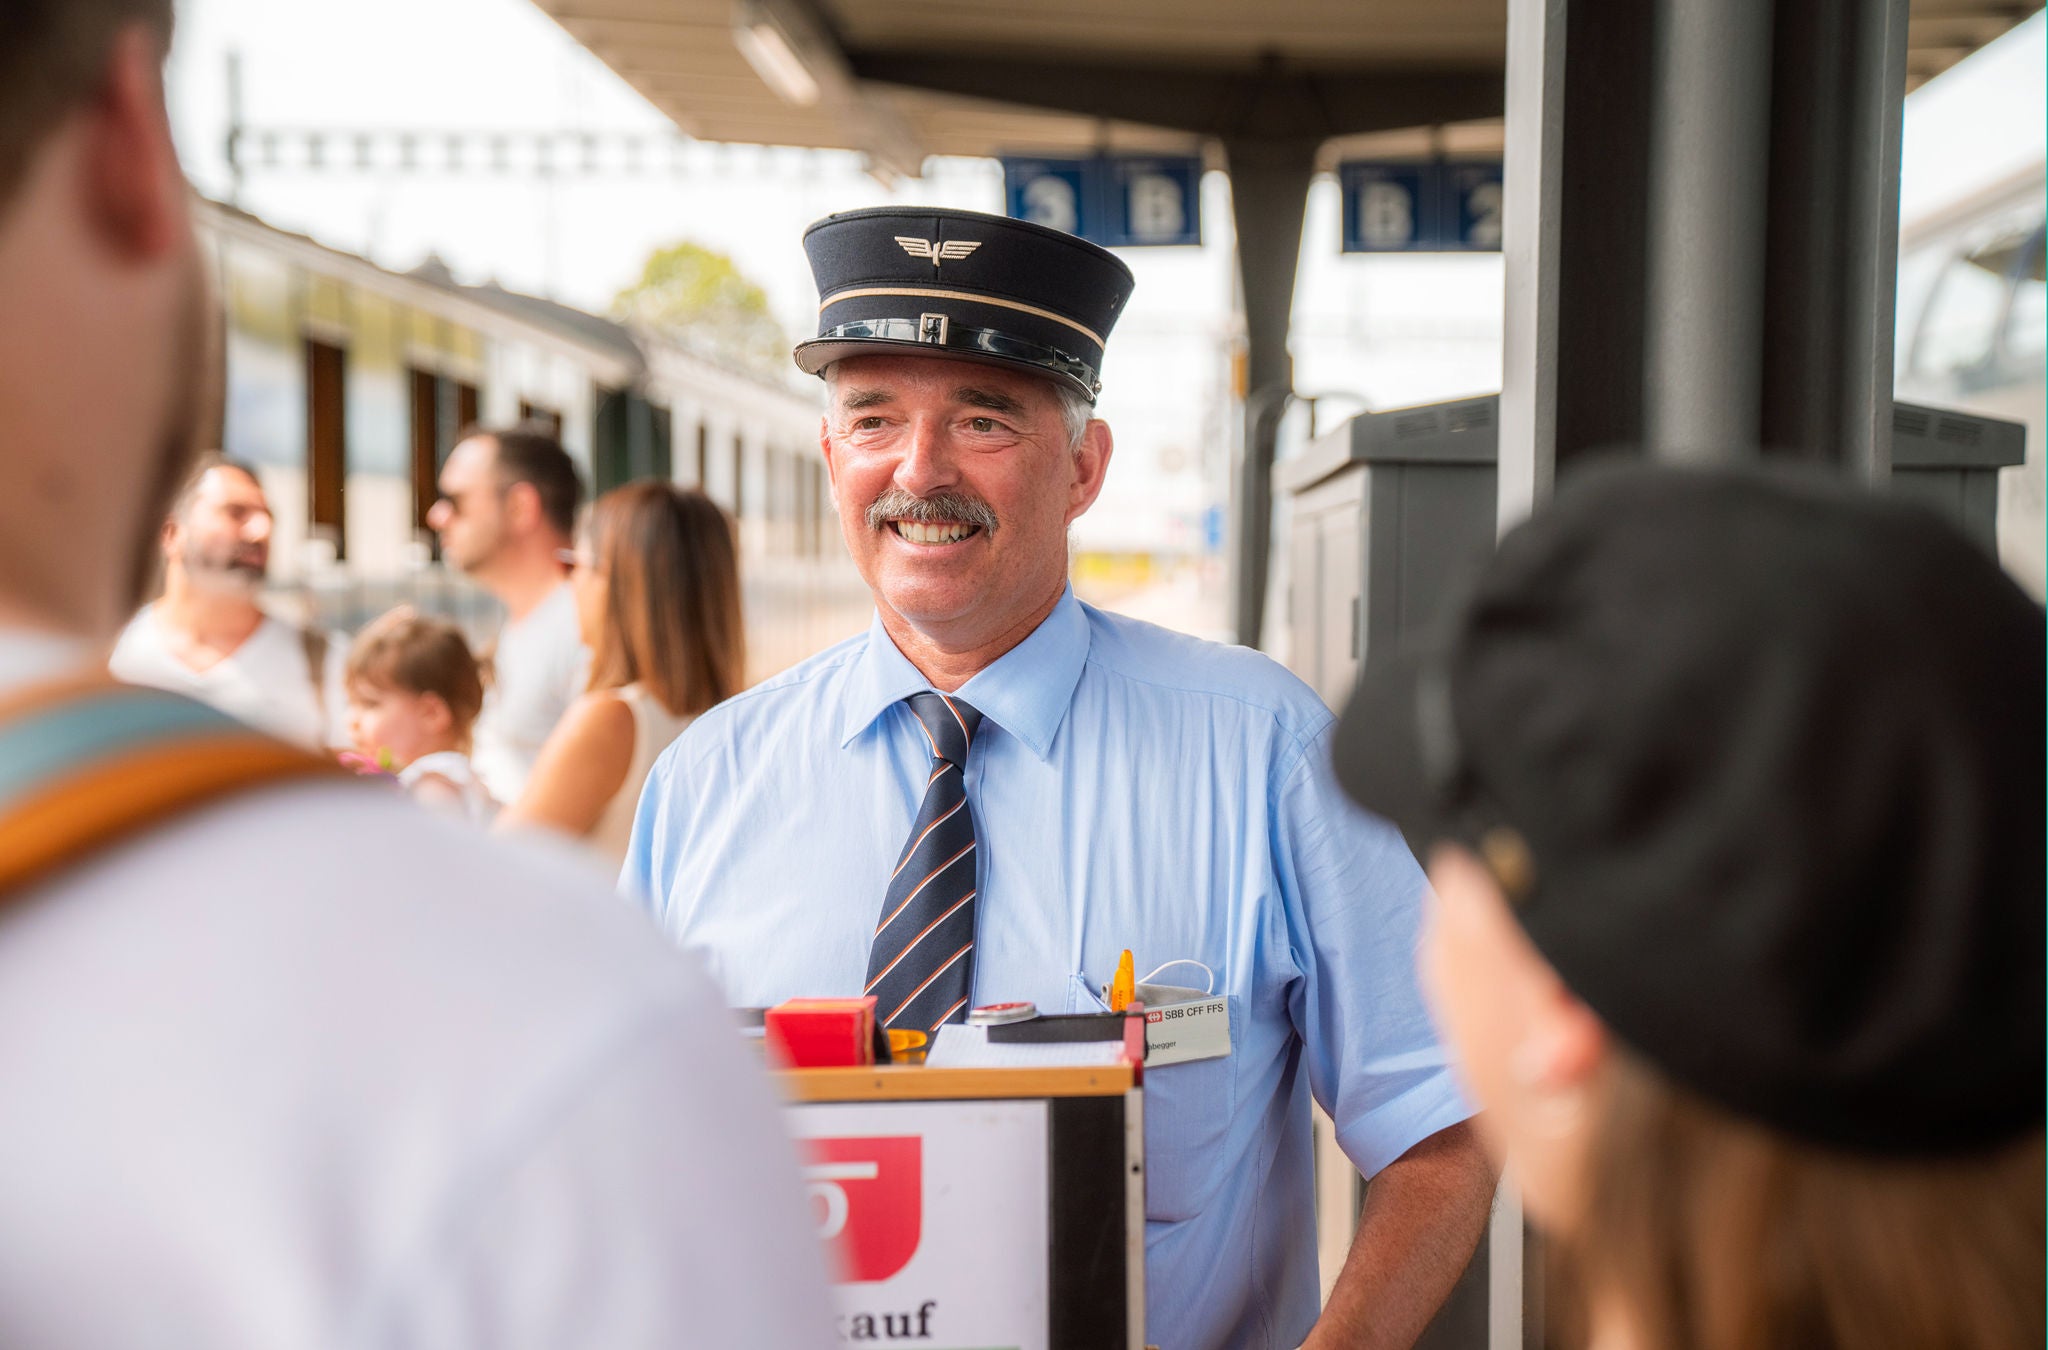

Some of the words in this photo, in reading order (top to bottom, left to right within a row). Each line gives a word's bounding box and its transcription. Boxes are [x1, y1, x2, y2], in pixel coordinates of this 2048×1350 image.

[1024, 175, 1077, 236] 3
[1129, 174, 1184, 241] B
[1361, 181, 1413, 246] B
[1165, 1009, 1184, 1020] SBB
[1187, 1006, 1204, 1017] CFF
[1207, 1003, 1224, 1014] FFS
